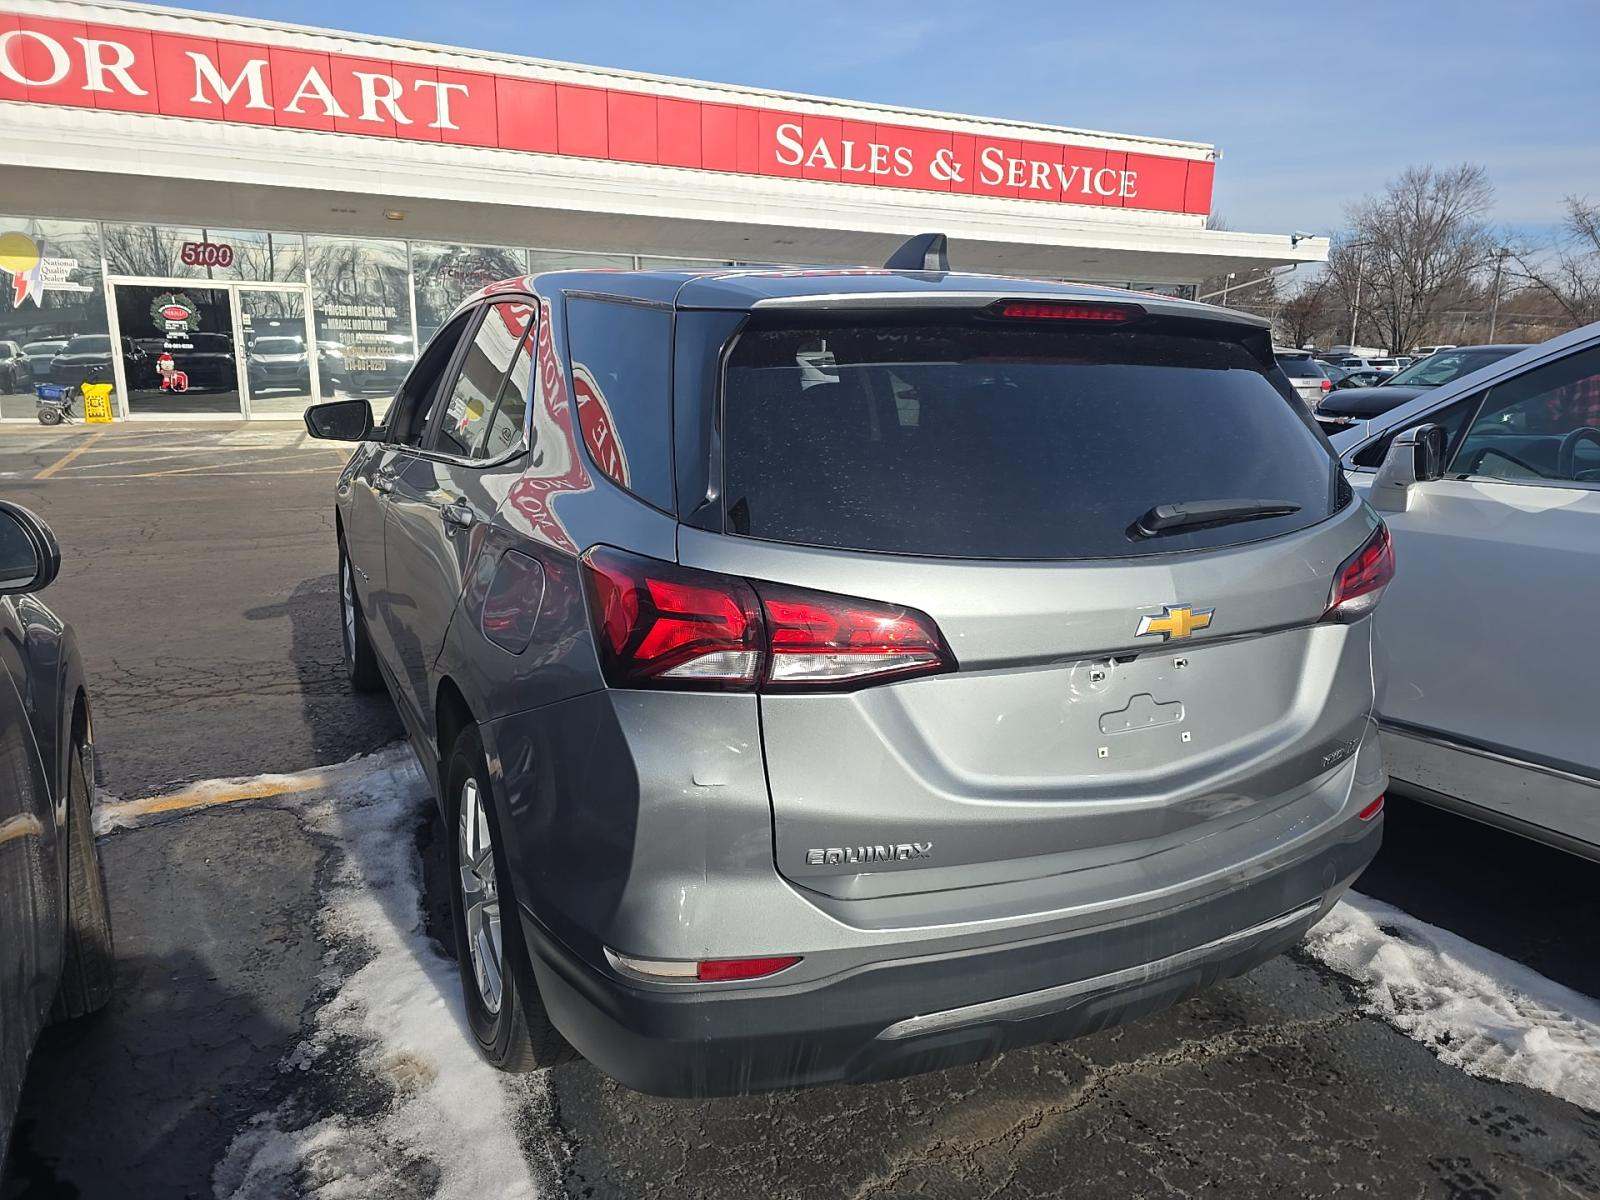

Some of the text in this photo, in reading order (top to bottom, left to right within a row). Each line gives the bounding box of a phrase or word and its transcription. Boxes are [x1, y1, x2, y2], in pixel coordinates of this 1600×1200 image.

[0, 30, 470, 130] OR MART
[775, 123, 1138, 198] SALES & SERVICE
[43, 258, 75, 266] National
[182, 242, 233, 267] 5100
[41, 266, 69, 275] Quality
[806, 842, 933, 865] EQUINOX
